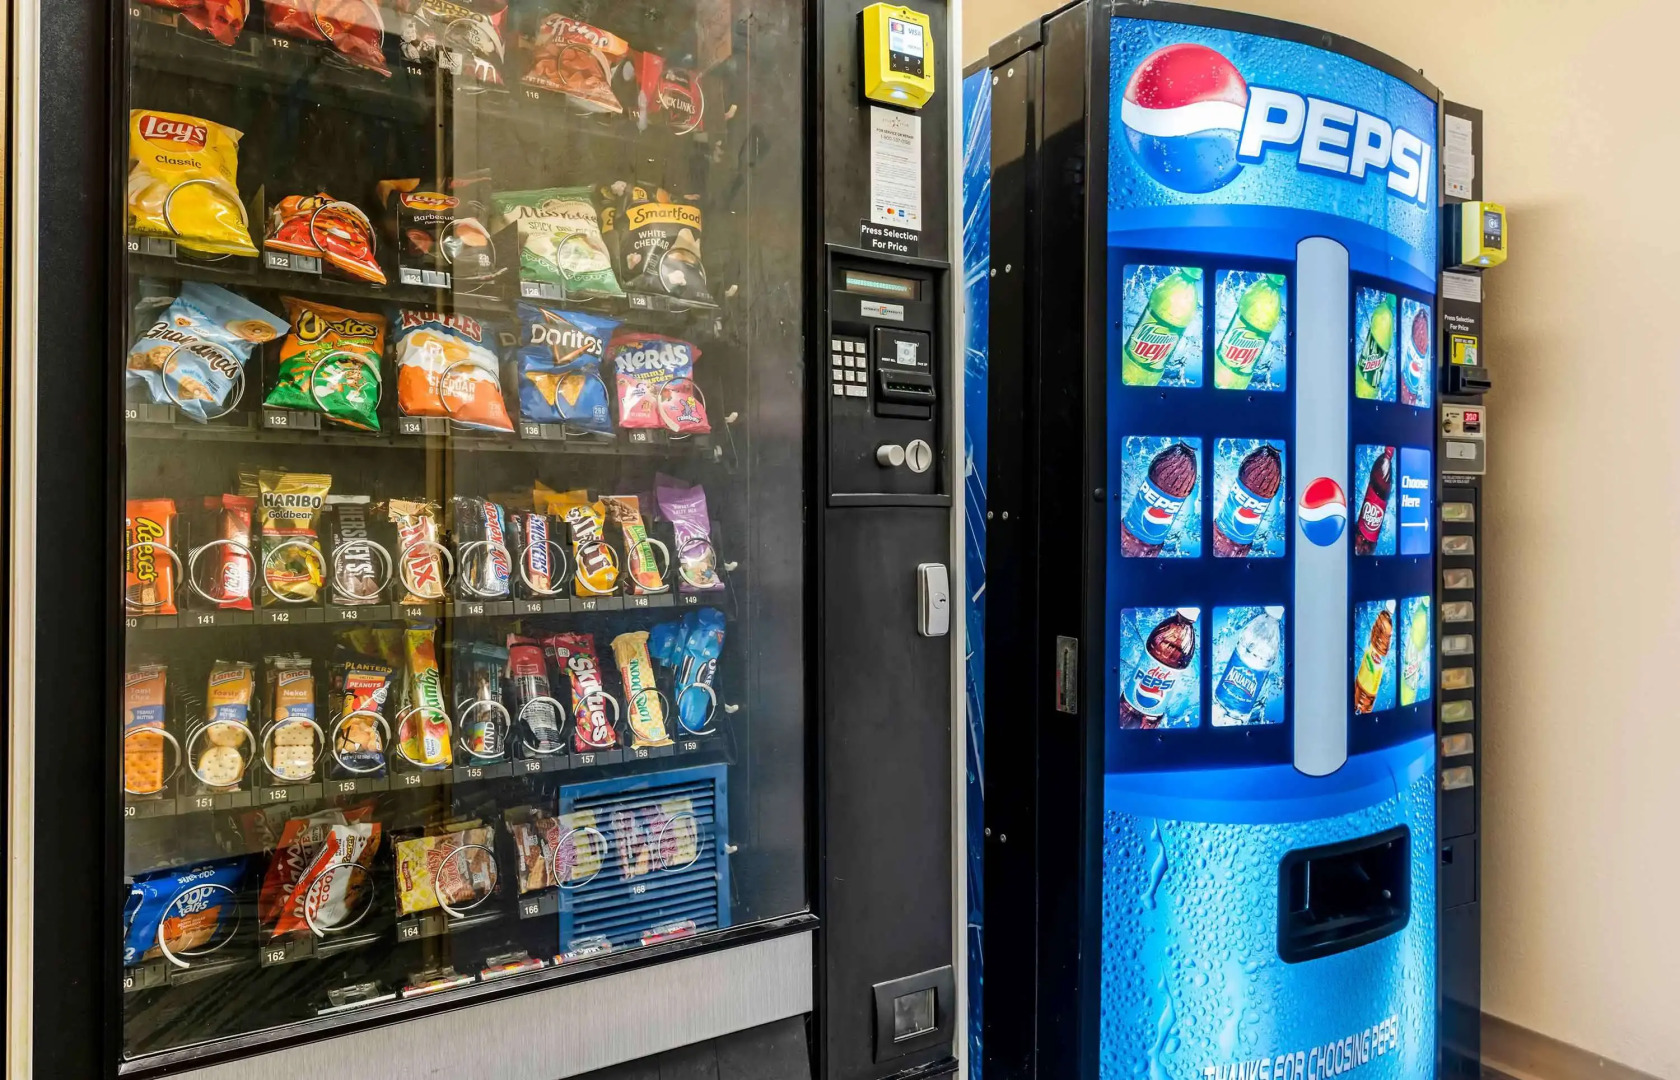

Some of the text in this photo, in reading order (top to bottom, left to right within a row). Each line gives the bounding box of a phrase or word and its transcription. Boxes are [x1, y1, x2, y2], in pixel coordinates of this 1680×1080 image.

[272, 38, 289, 48] 112
[407, 66, 422, 75] 114
[525, 91, 539, 99] 116
[145, 117, 206, 142] Lay's
[1239, 86, 1432, 202] PEPSI
[155, 155, 202, 169] Classic
[414, 213, 455, 222] Barbecue
[519, 206, 558, 219] Miss
[634, 207, 700, 224] Smartfood
[528, 221, 552, 232] SPICY
[638, 229, 667, 240] WHITE
[861, 225, 918, 242] Press Selection
[634, 238, 670, 251] CHEDDAR
[872, 239, 908, 252] For Price
[271, 257, 288, 266] 122
[525, 288, 539, 296] 126
[632, 297, 646, 305] 128
[1455, 315, 1475, 323] Selection
[299, 310, 376, 340] Chetos
[1457, 323, 1469, 331] Price
[530, 323, 602, 356] Doritos
[270, 416, 287, 425] 132
[404, 424, 420, 432] 134
[524, 427, 539, 435] 136
[1401, 475, 1429, 489] Choose
[262, 492, 323, 509] HARIBO
[1401, 494, 1421, 508] Here
[530, 513, 548, 574] SNICKERS
[135, 517, 165, 583] Reese's
[400, 516, 436, 589] TWIX
[635, 598, 648, 606] 148
[684, 596, 697, 604] 149
[406, 608, 421, 616] 144
[468, 605, 483, 614] 145
[527, 604, 541, 612] 146
[197, 615, 214, 624] 141
[271, 613, 289, 622] 142
[341, 610, 358, 619] 143
[345, 661, 393, 674] PLANTERS
[1147, 666, 1170, 680] diet
[212, 671, 243, 682] Lance
[280, 670, 310, 682] Lance
[629, 659, 642, 692] DOONE
[1134, 669, 1176, 691] PEPSI
[283, 689, 307, 697] Nekot
[425, 667, 445, 725] Mamba
[568, 657, 608, 742] Skittles
[484, 721, 497, 754] KIND
[684, 742, 697, 750] 159
[635, 749, 648, 758] 158
[581, 755, 595, 764] 157
[526, 762, 540, 771] 156
[467, 768, 482, 777] 155
[405, 775, 421, 785] 154
[338, 781, 355, 792] 153
[269, 790, 287, 800] 152
[196, 798, 213, 808] 151
[342, 835, 355, 869] Reese's
[633, 885, 646, 894] 168
[524, 905, 539, 915] 166
[403, 926, 419, 938] 164
[267, 951, 285, 962] 162
[1274, 1050, 1305, 1080] FOR
[1308, 1029, 1370, 1079] CHOOSING
